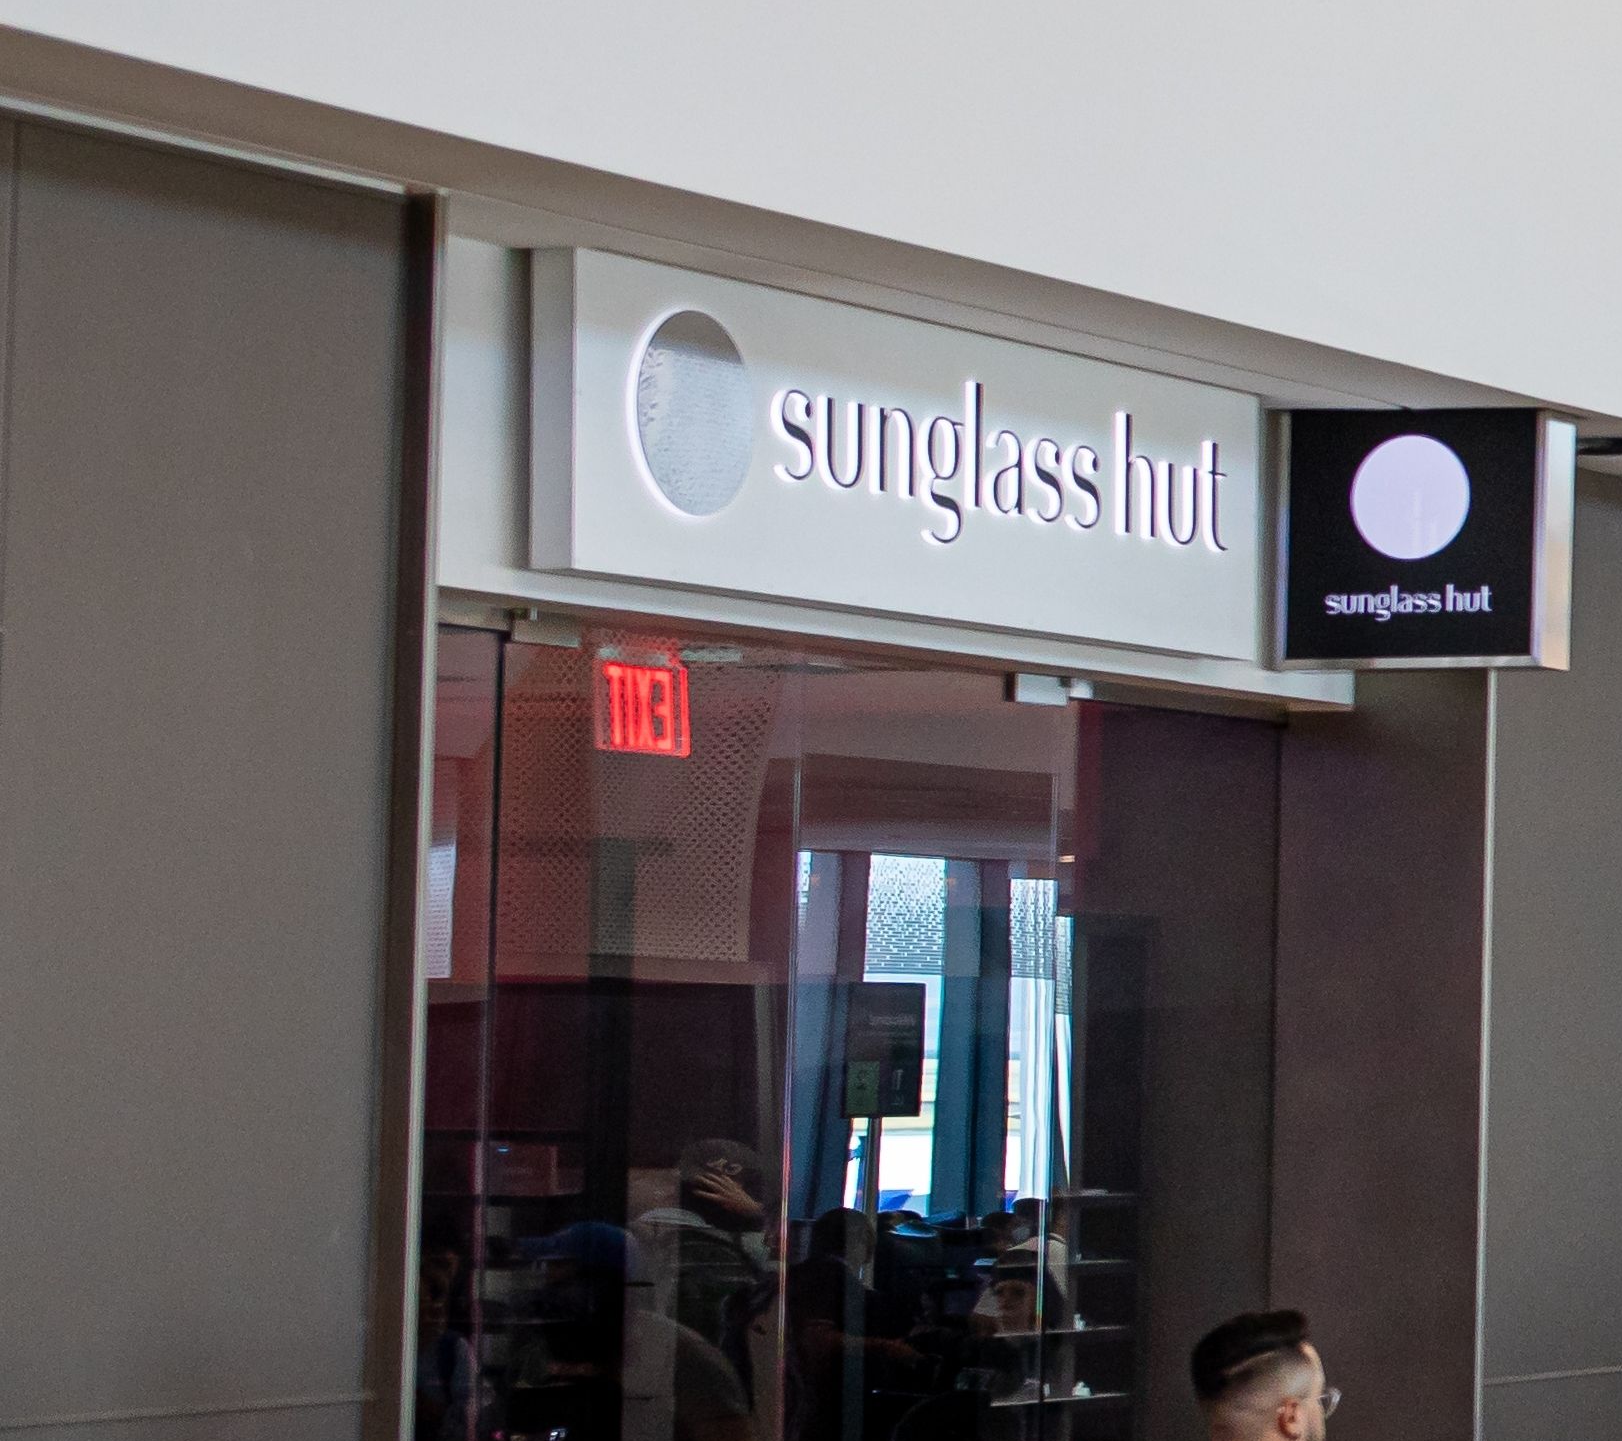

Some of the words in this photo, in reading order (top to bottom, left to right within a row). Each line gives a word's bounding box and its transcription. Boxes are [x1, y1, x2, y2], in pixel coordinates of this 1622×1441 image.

[770, 380, 1103, 544] sunglass
[1112, 408, 1231, 553] hut
[1323, 584, 1442, 622] sunglass
[1445, 584, 1493, 613] hut
